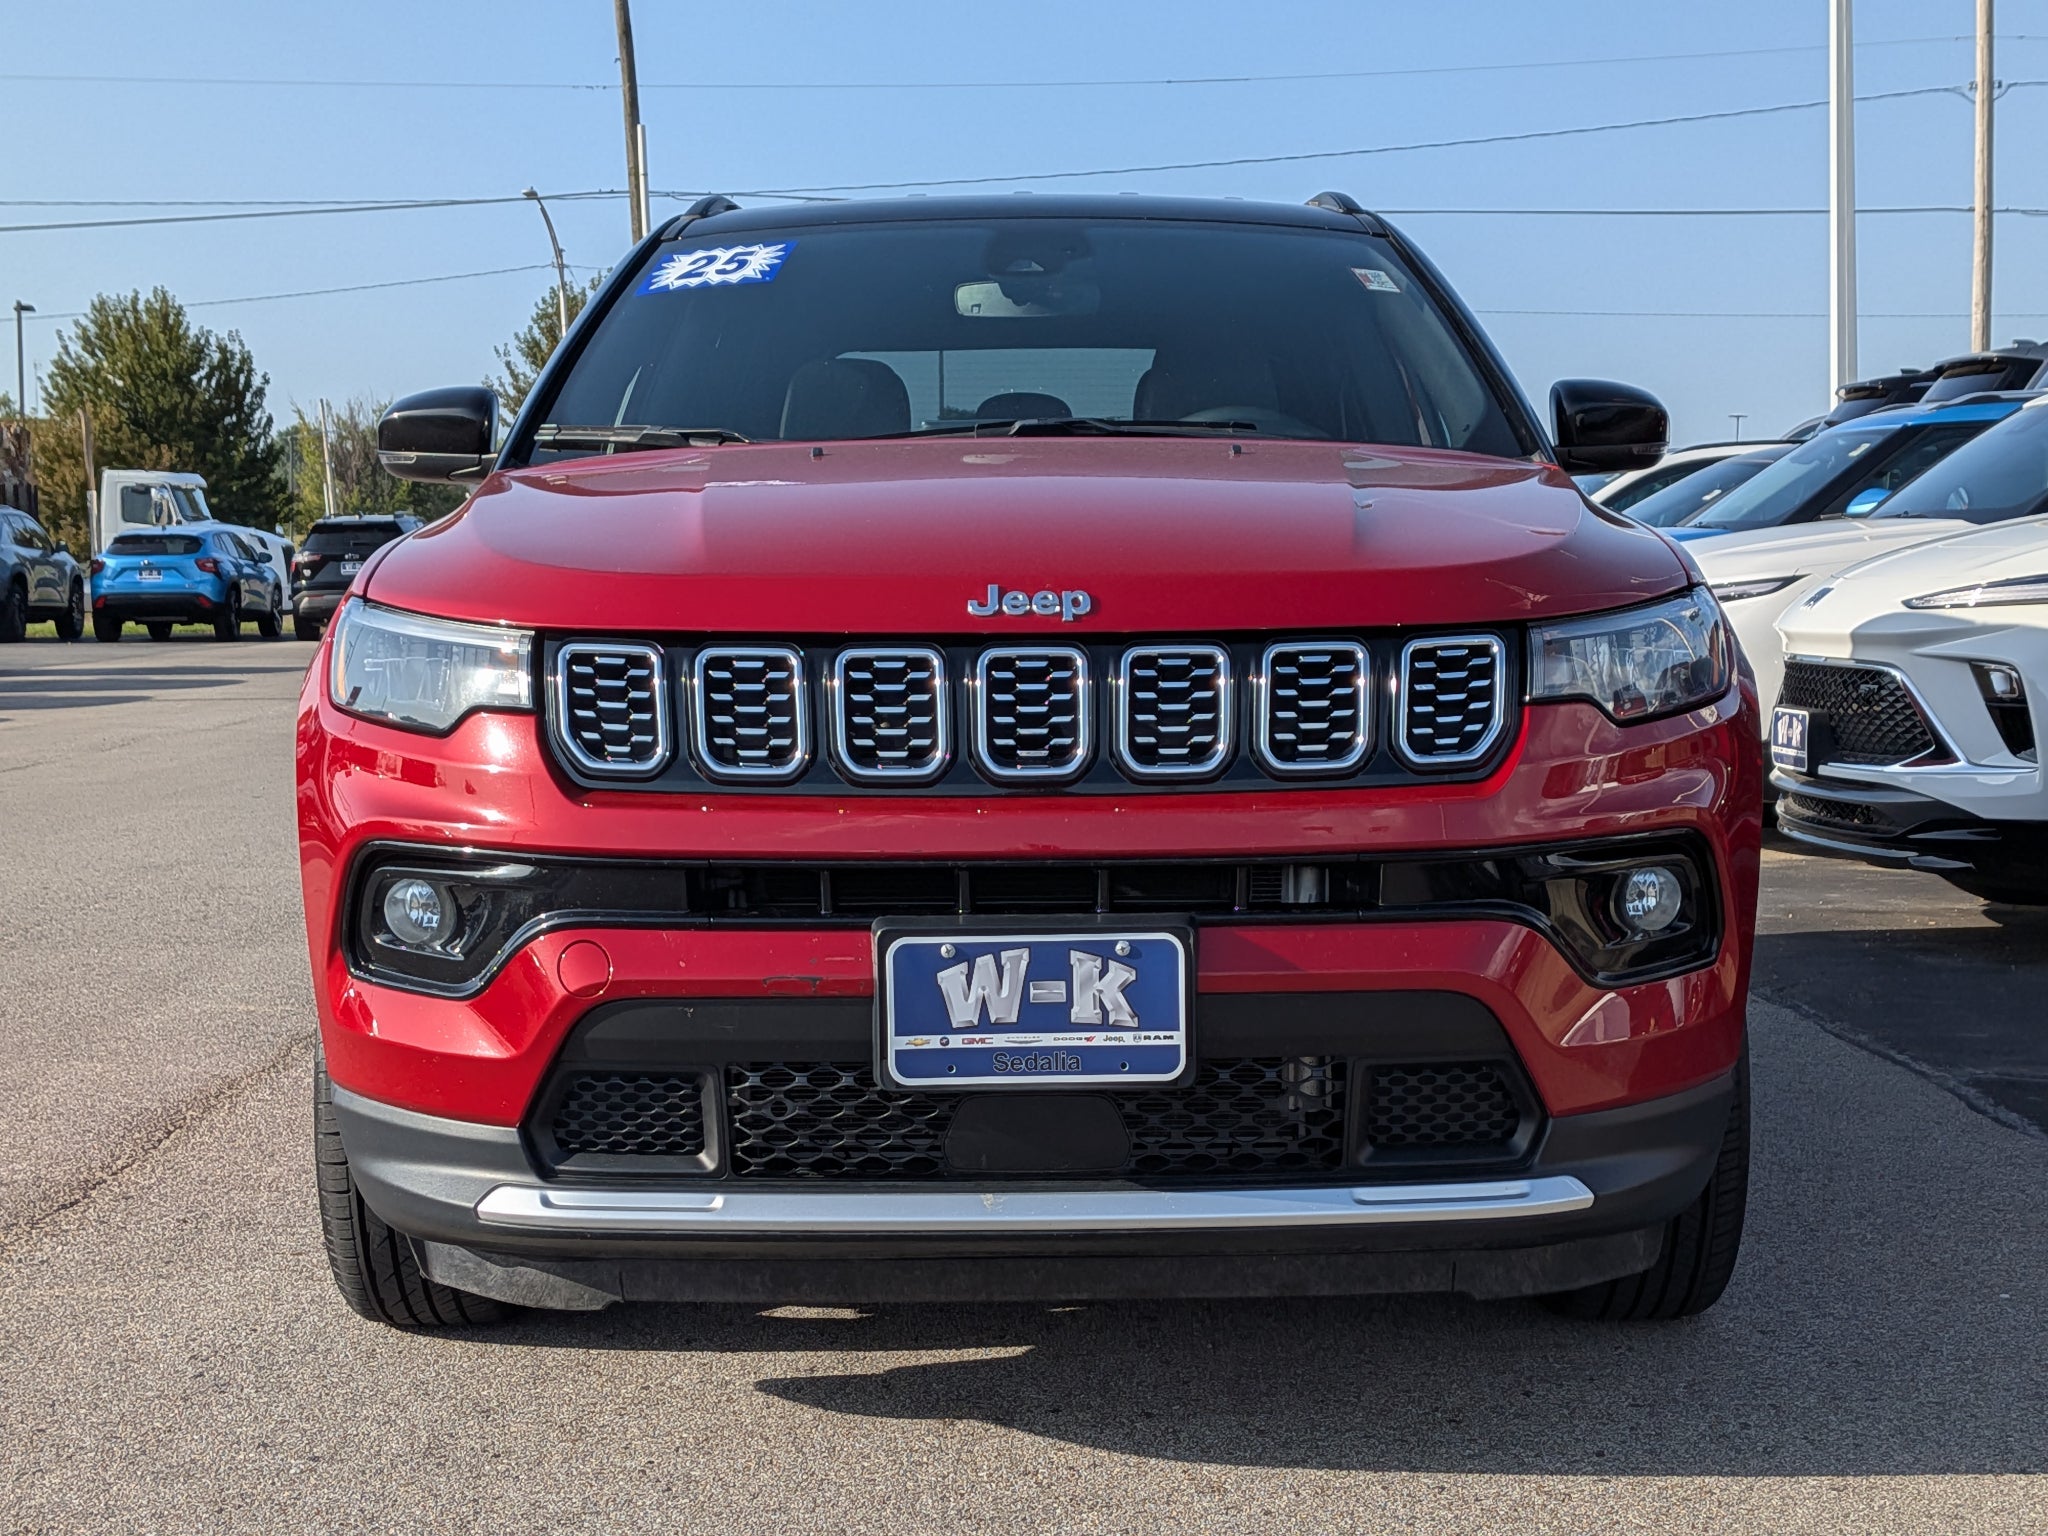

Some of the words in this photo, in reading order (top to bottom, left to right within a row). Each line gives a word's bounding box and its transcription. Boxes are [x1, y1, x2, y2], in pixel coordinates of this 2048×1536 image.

[674, 250, 757, 281] 25
[967, 584, 1092, 621] Jeep
[937, 948, 1139, 1028] W-K
[961, 1037, 994, 1045] GMC
[1103, 1034, 1125, 1043] Jeep
[992, 1051, 1082, 1073] Sedalia
